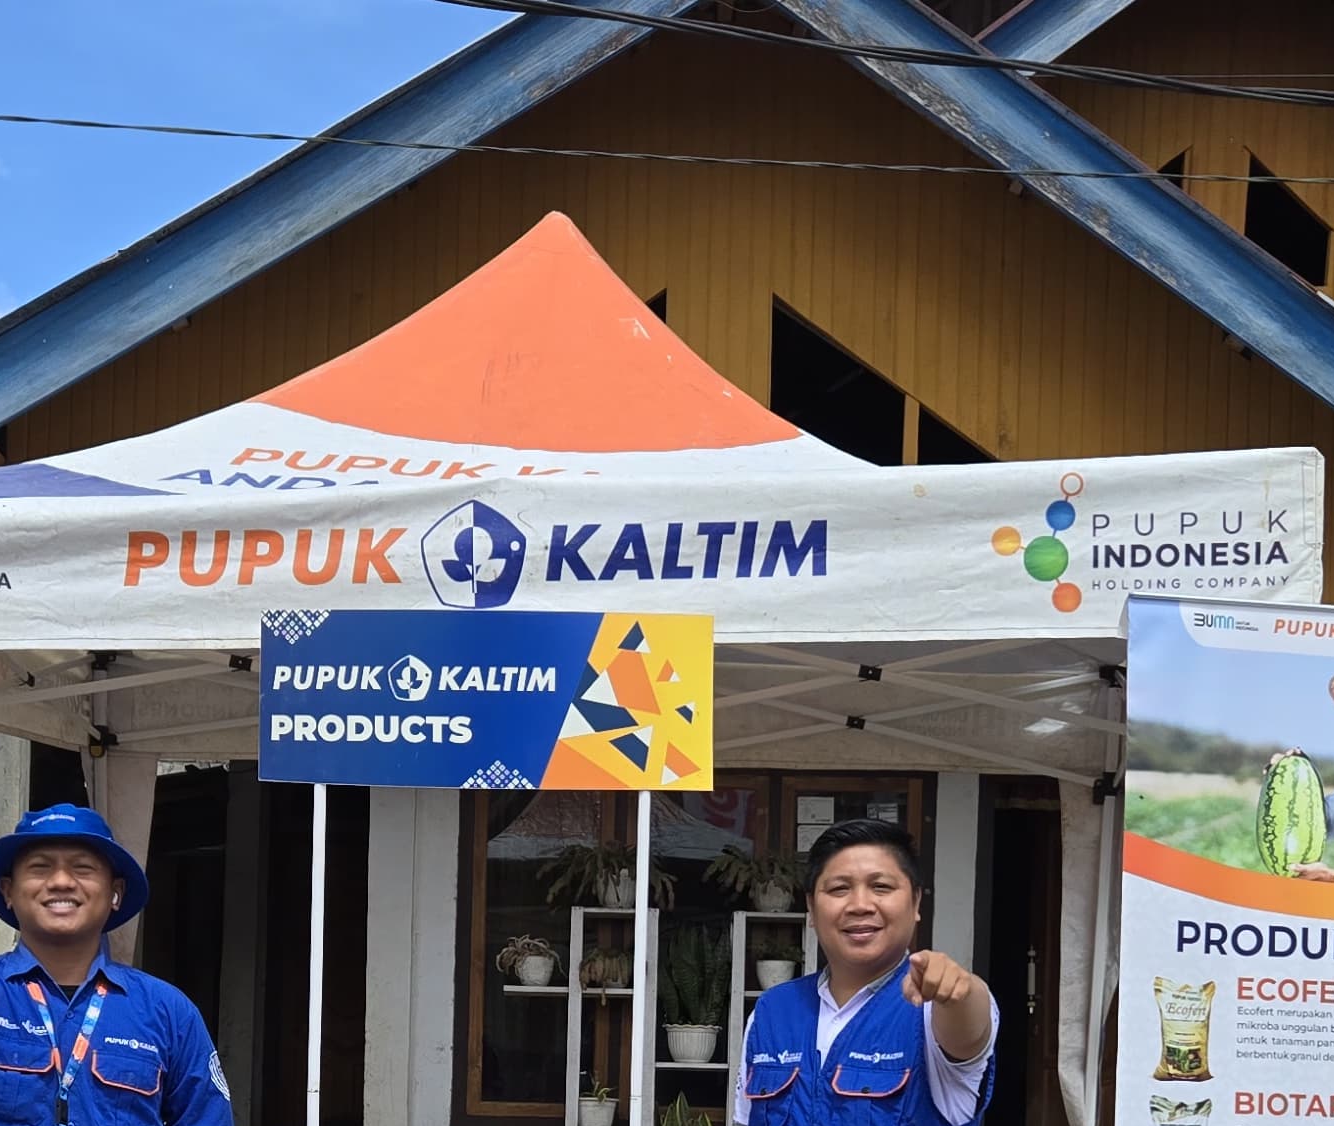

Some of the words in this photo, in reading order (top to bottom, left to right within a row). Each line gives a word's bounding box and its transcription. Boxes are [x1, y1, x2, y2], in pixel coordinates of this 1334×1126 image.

[230, 448, 500, 479] PUPUK
[159, 469, 380, 490] AND
[1092, 509, 1288, 536] PUPUK
[124, 528, 408, 587] PUPUK
[545, 520, 827, 582] KALTIM
[1092, 542, 1289, 568] INDONESIA
[1092, 578, 1184, 592] HOLDING
[1194, 575, 1289, 589] COMPANY
[1194, 613, 1235, 629] BUMN
[272, 666, 383, 690] PUPUK
[439, 667, 556, 691] KALTIM
[271, 714, 472, 744] PRODUCTS
